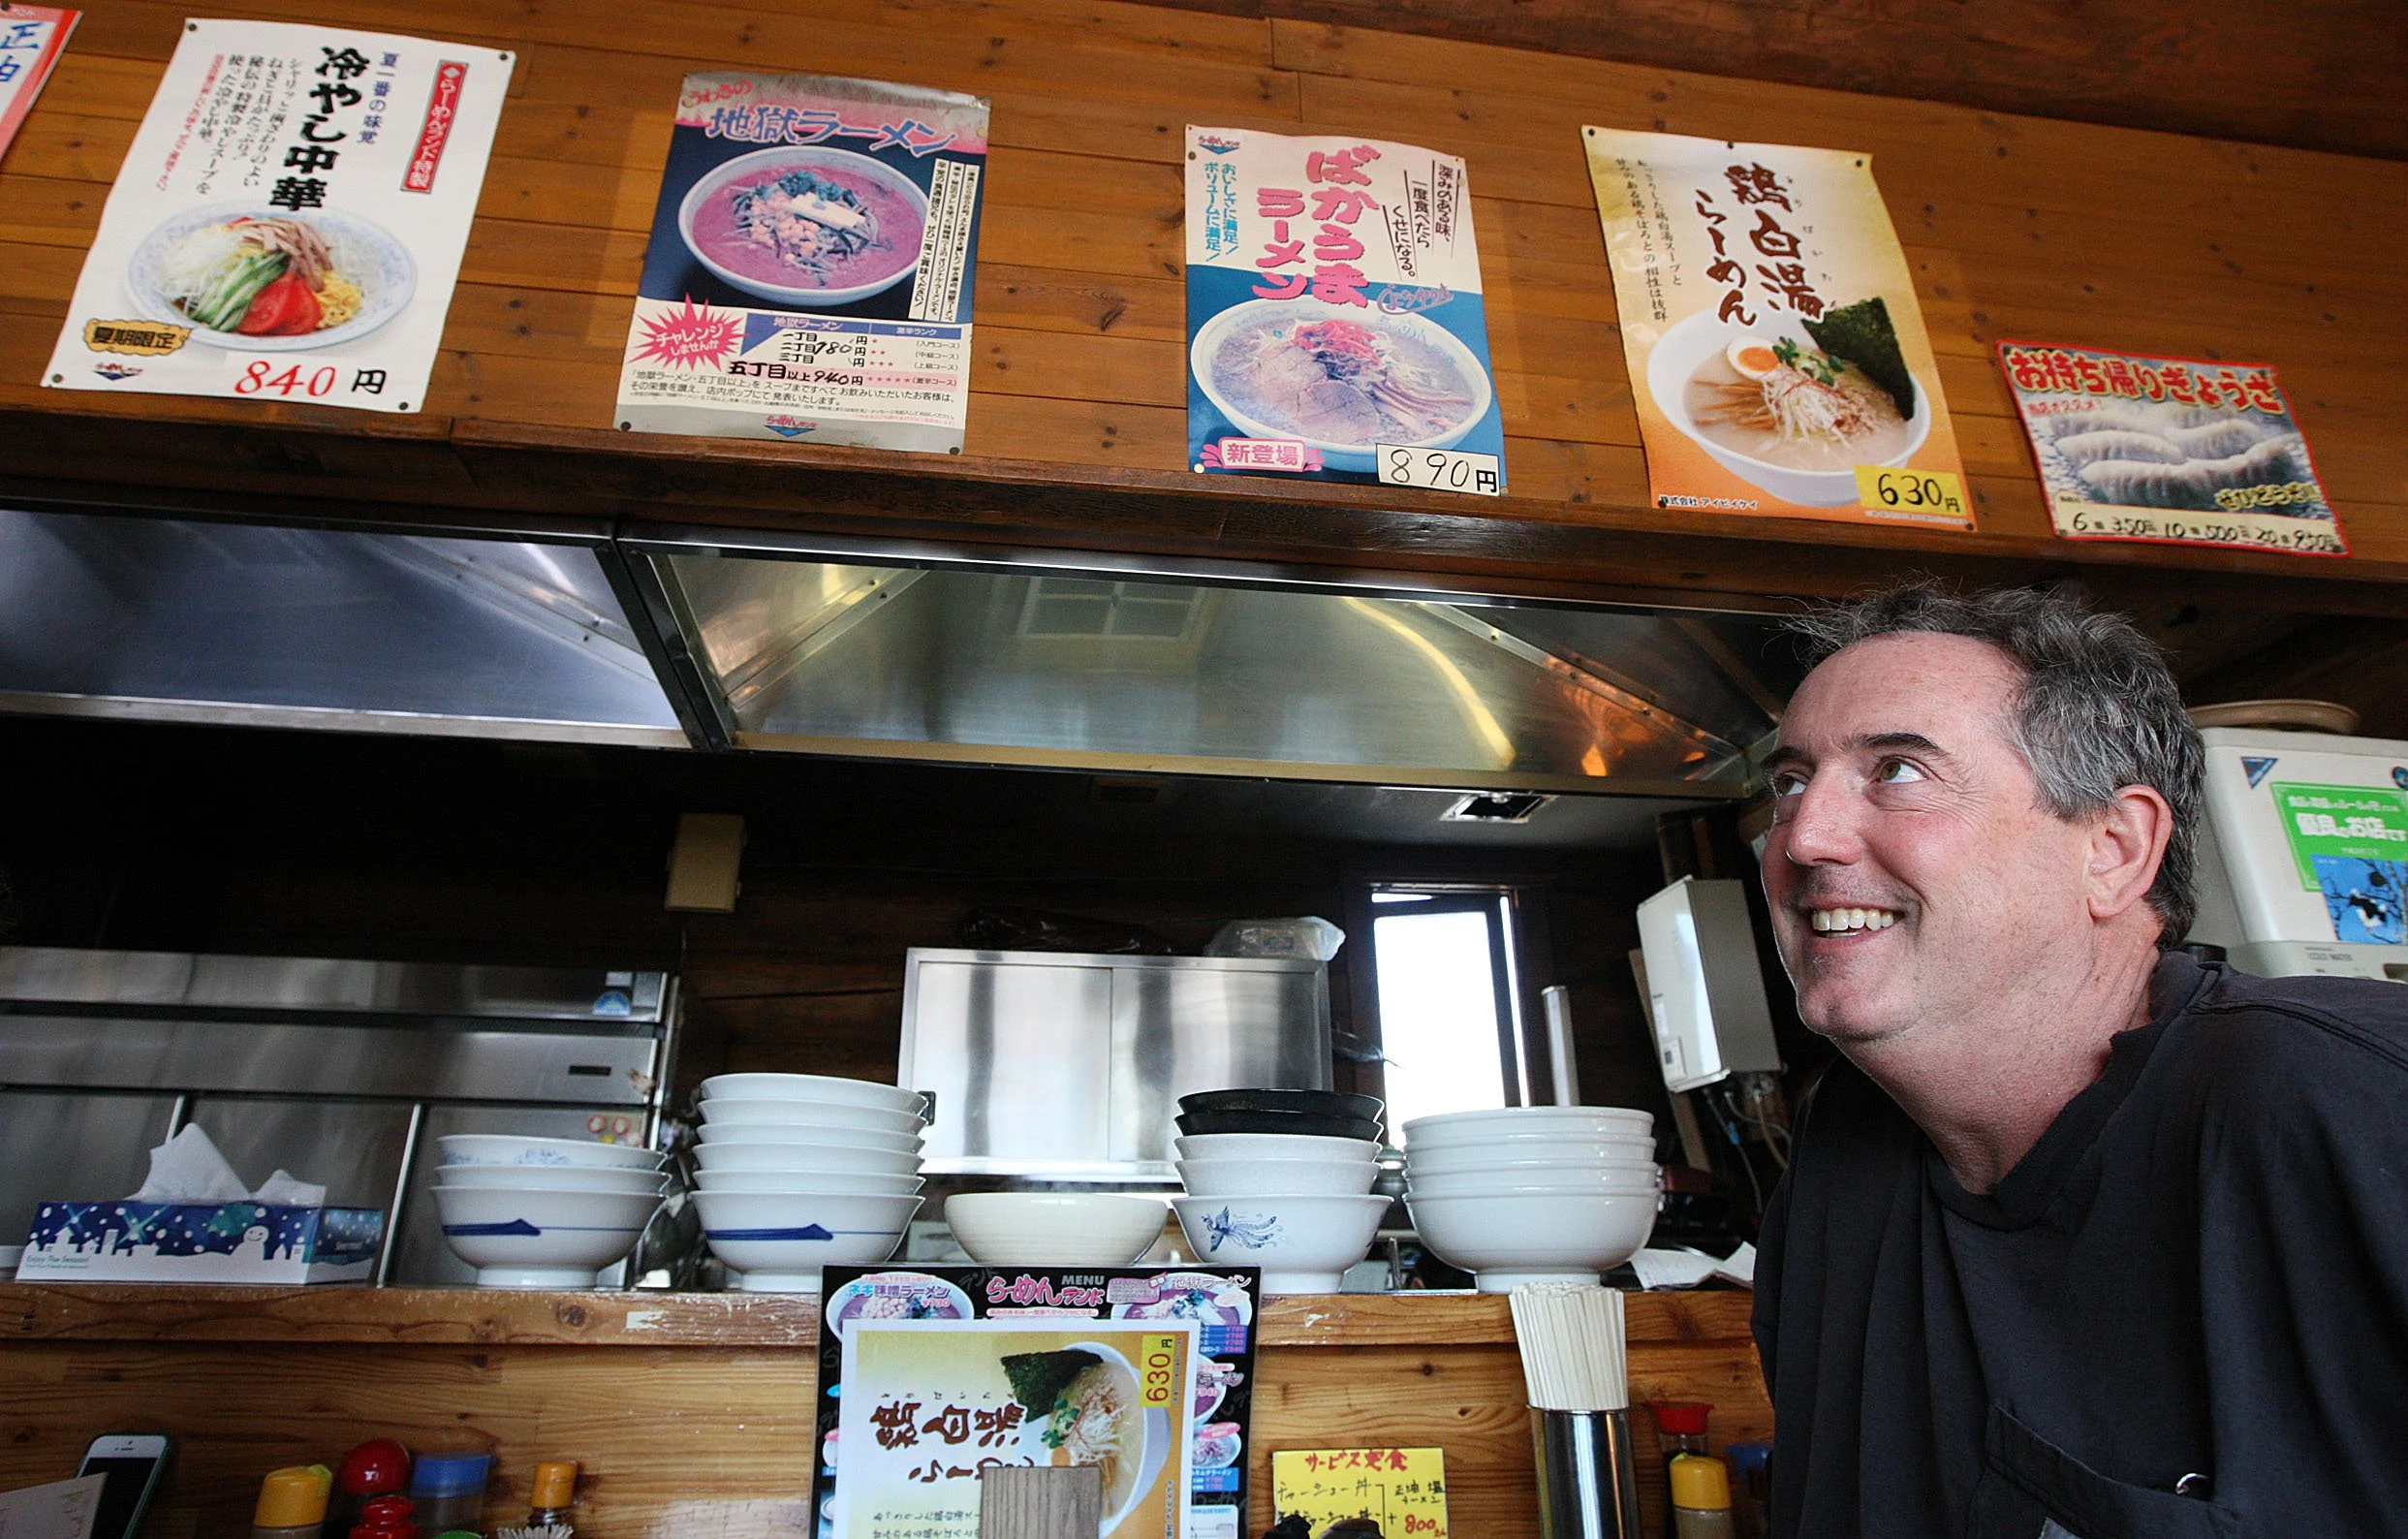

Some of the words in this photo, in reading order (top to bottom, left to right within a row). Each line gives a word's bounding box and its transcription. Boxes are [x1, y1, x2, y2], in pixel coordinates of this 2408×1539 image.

[357, 51, 400, 144] 夏一番の味覚
[269, 47, 370, 211] 冷やし中華
[705, 106, 957, 158] 地獄ラーメン
[1412, 180, 1430, 249] 一度食べたら
[1436, 163, 1454, 243] 深みのある味、
[1305, 144, 1382, 309] ばかうま
[1392, 204, 1416, 278] くせになる。
[1724, 162, 1825, 319] 鶏白湯
[1252, 187, 1306, 300] ラーメン
[1696, 189, 1757, 327] らーめん
[93, 327, 176, 349] 夏期限定
[656, 323, 724, 347] チャレンジ
[773, 317, 843, 332] 地獄ラーメン
[782, 332, 817, 342] 一丁目
[856, 335, 867, 346] 円
[670, 339, 720, 356] しませんか
[779, 353, 814, 363] 三丁目
[853, 358, 864, 367] 円
[780, 343, 816, 354] 二丁目
[2011, 349, 2284, 414] お持ち帰りぎょうざ
[1227, 443, 1300, 466] 新登場
[1878, 473, 1960, 513] 630円
[1062, 1275, 1105, 1286] MENU
[1173, 1274, 1253, 1291] 地獄ラーメン
[870, 1400, 1025, 1450] 鶏白湯
[909, 1456, 1034, 1482] らー
[1304, 1449, 1408, 1472] サービス定食
[1277, 1477, 1372, 1502] チャーシュー丼
